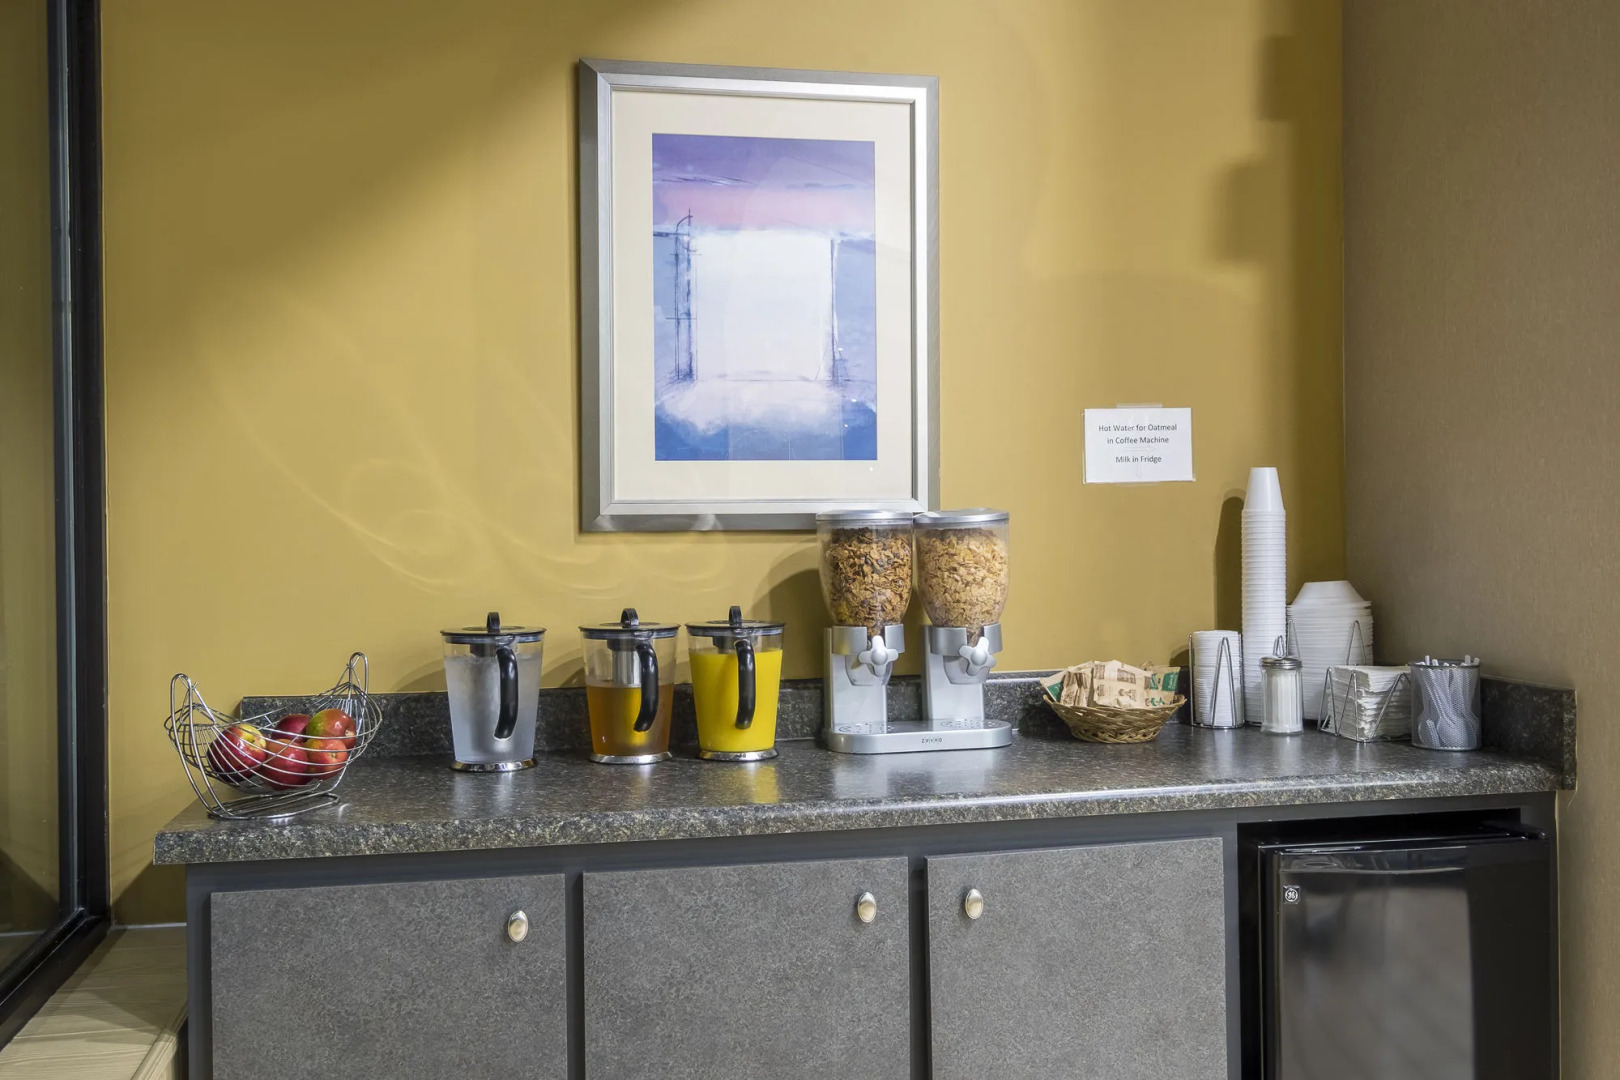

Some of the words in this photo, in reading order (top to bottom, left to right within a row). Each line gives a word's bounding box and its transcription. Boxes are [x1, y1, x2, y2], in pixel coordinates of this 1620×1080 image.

[1147, 423, 1177, 431] Oatmeal
[1115, 436, 1138, 444] Coffee
[1139, 436, 1169, 444] Machine
[1115, 455, 1131, 463] Milk
[1140, 455, 1162, 463] Fridge
